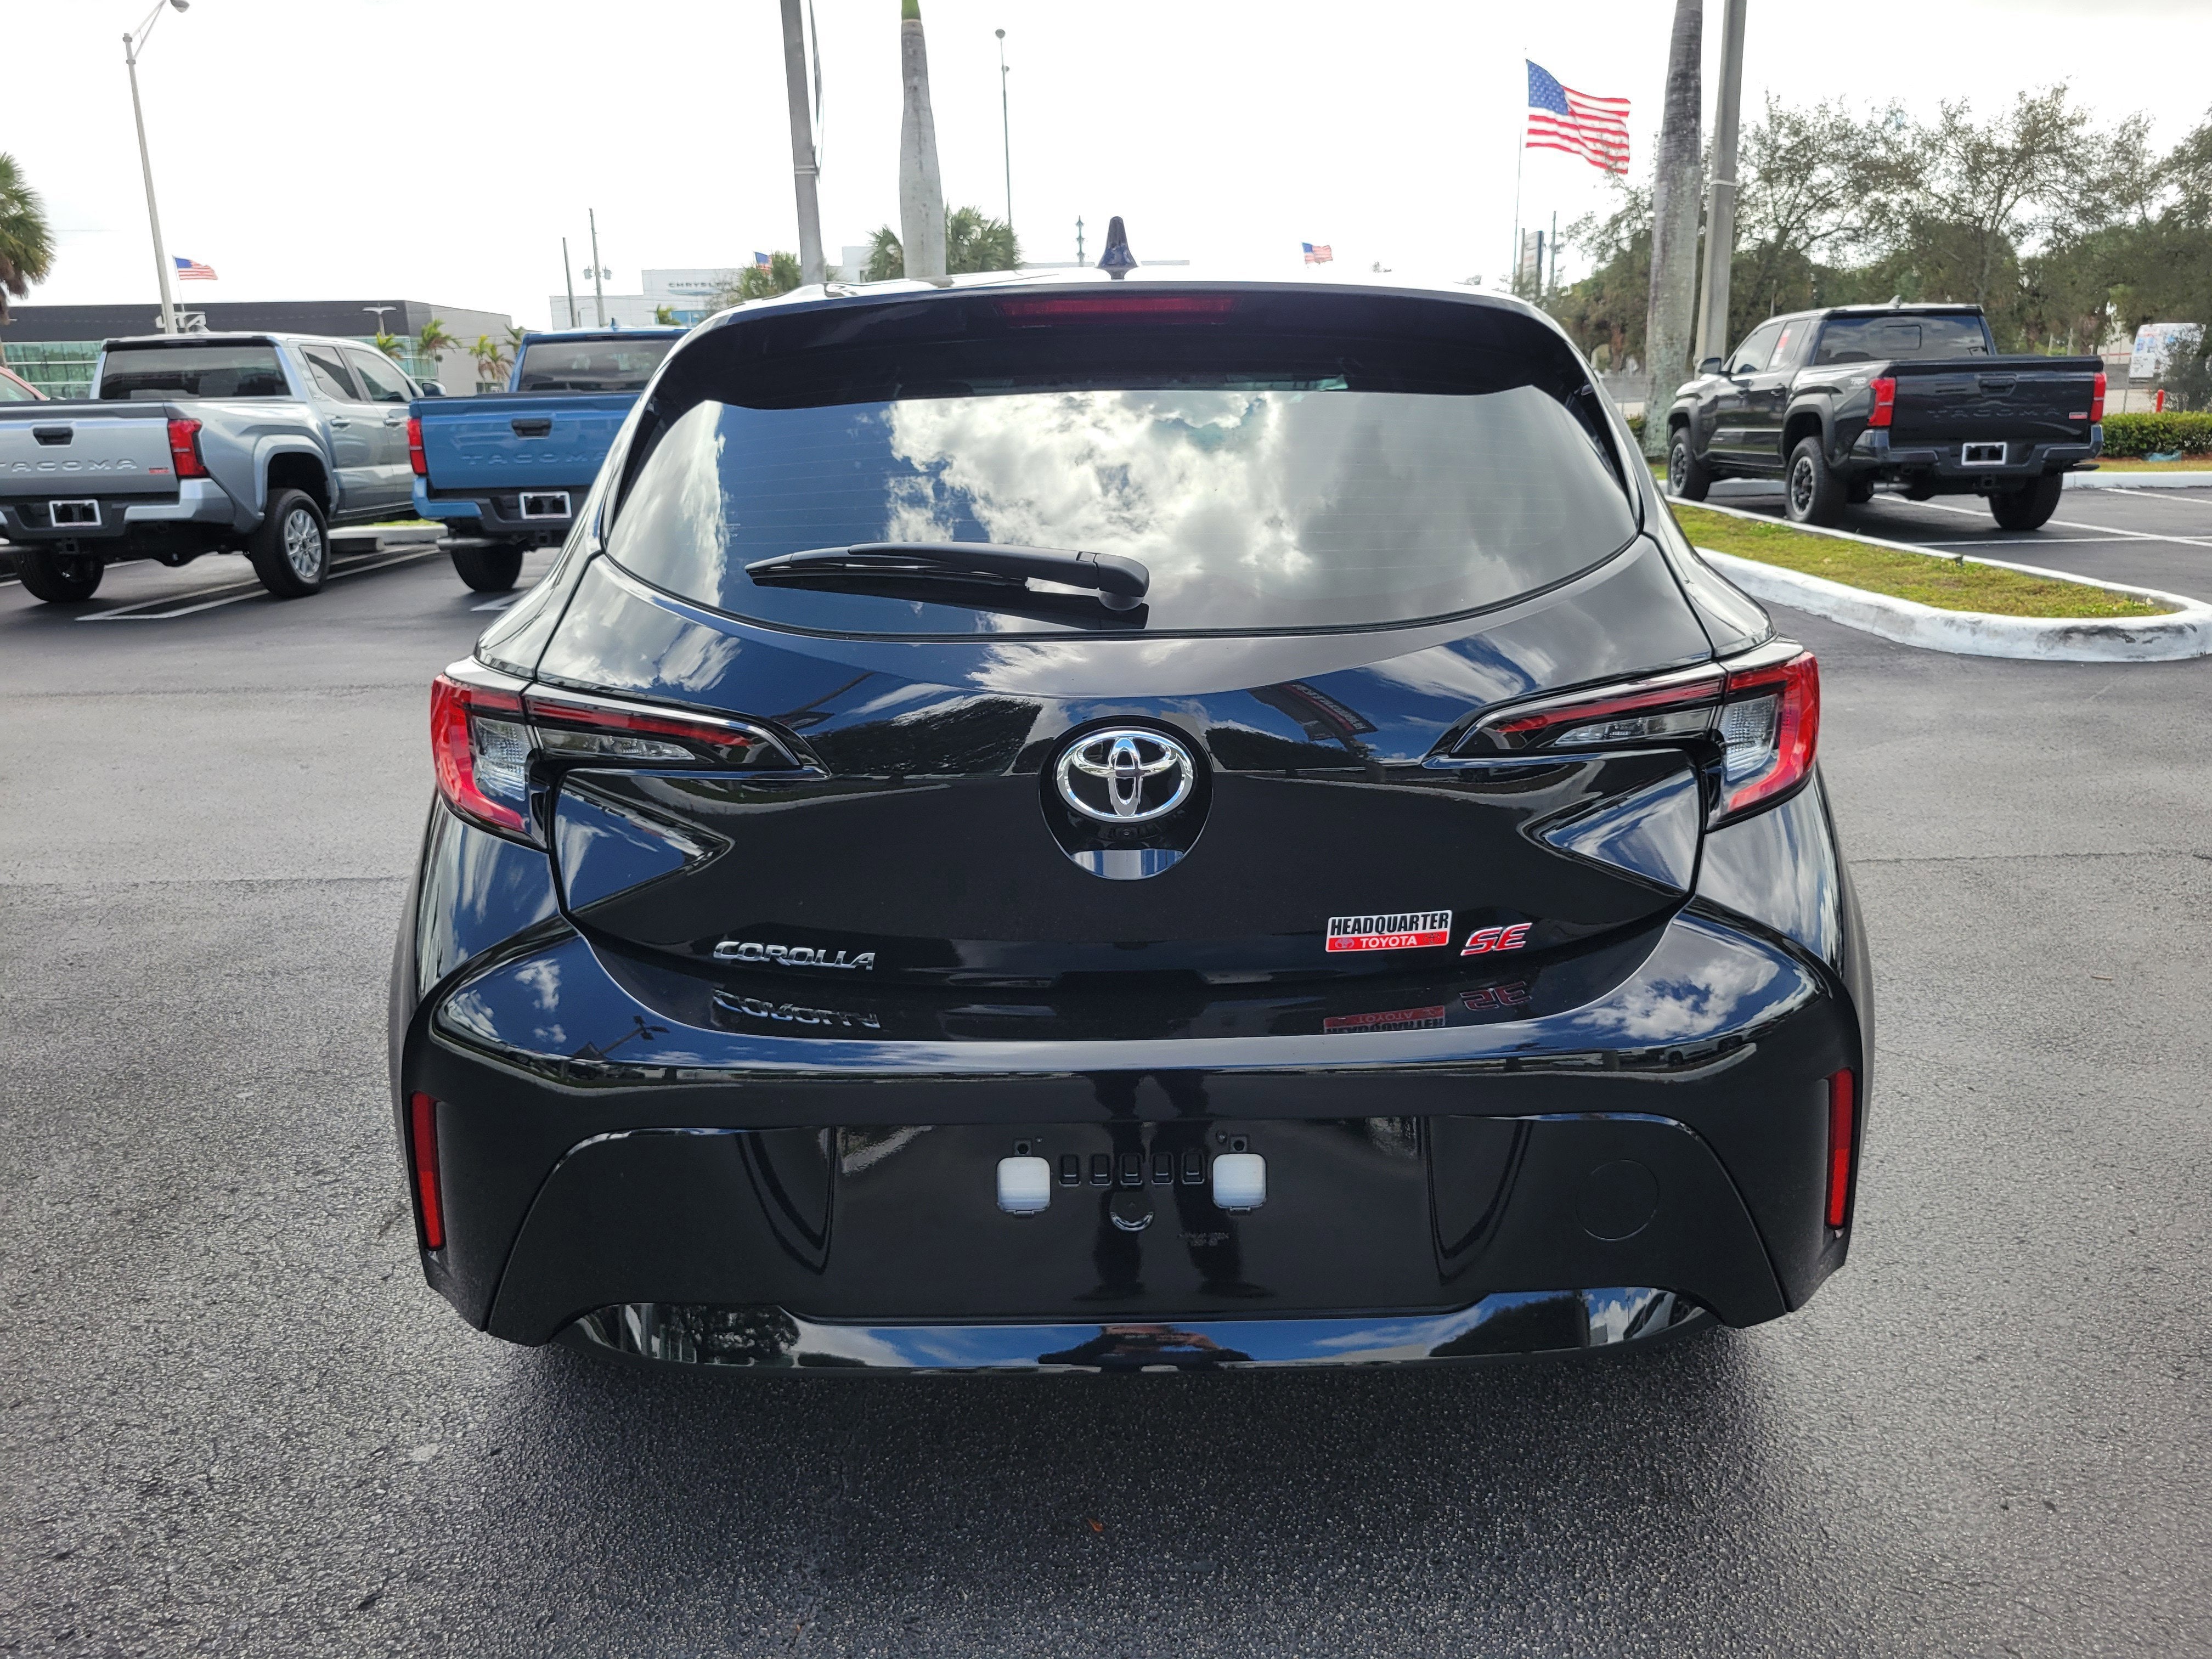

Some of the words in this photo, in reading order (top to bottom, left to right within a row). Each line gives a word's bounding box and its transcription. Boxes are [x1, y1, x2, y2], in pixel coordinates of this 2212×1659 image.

[1330, 912, 1449, 936] HEADQUARTER
[1360, 935, 1417, 949] TOYOTA
[1460, 922, 1533, 956] SE
[713, 941, 876, 970] COROLLA
